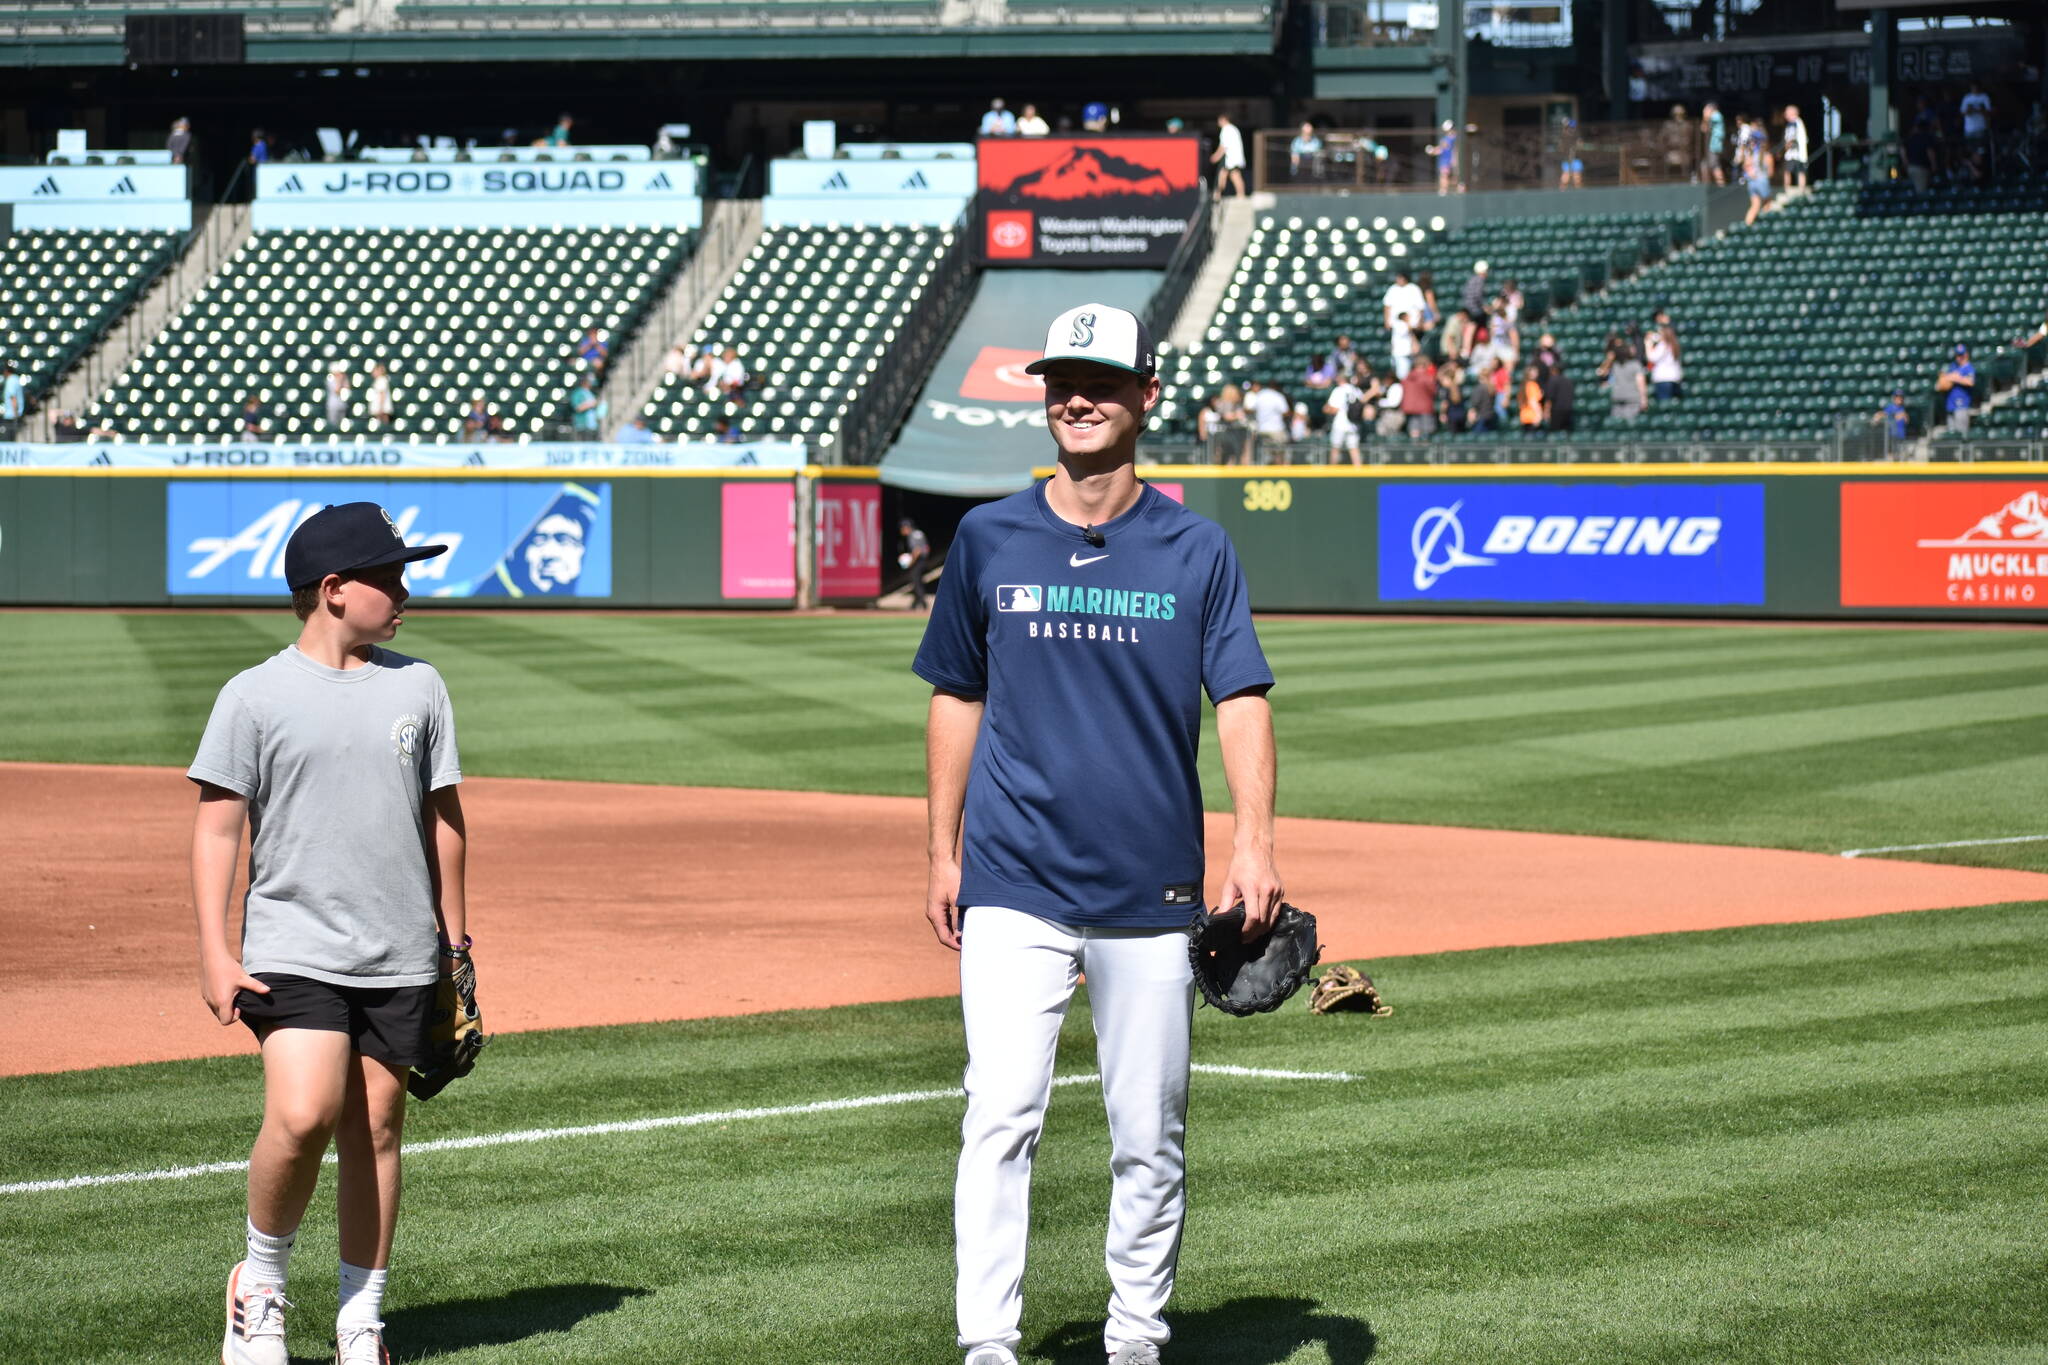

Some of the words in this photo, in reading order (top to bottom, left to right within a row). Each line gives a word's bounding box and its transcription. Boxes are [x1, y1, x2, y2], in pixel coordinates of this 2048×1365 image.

[325, 172, 452, 193] J-ROD
[483, 170, 625, 192] SQUAD
[1039, 217, 1099, 234] Western
[1100, 216, 1188, 237] Washington
[1039, 235, 1089, 255] Toyota
[1089, 235, 1149, 252] Dealers
[1069, 312, 1097, 348] S
[172, 449, 270, 466] J-ROD
[293, 449, 402, 466] SQUAD
[1243, 480, 1292, 511] 380
[187, 499, 464, 588] Alka
[1482, 515, 1722, 556] BOEING
[1047, 585, 1177, 620] MARINERS
[1946, 583, 2036, 602] CASINO
[1029, 621, 1140, 643] BASEBALL
